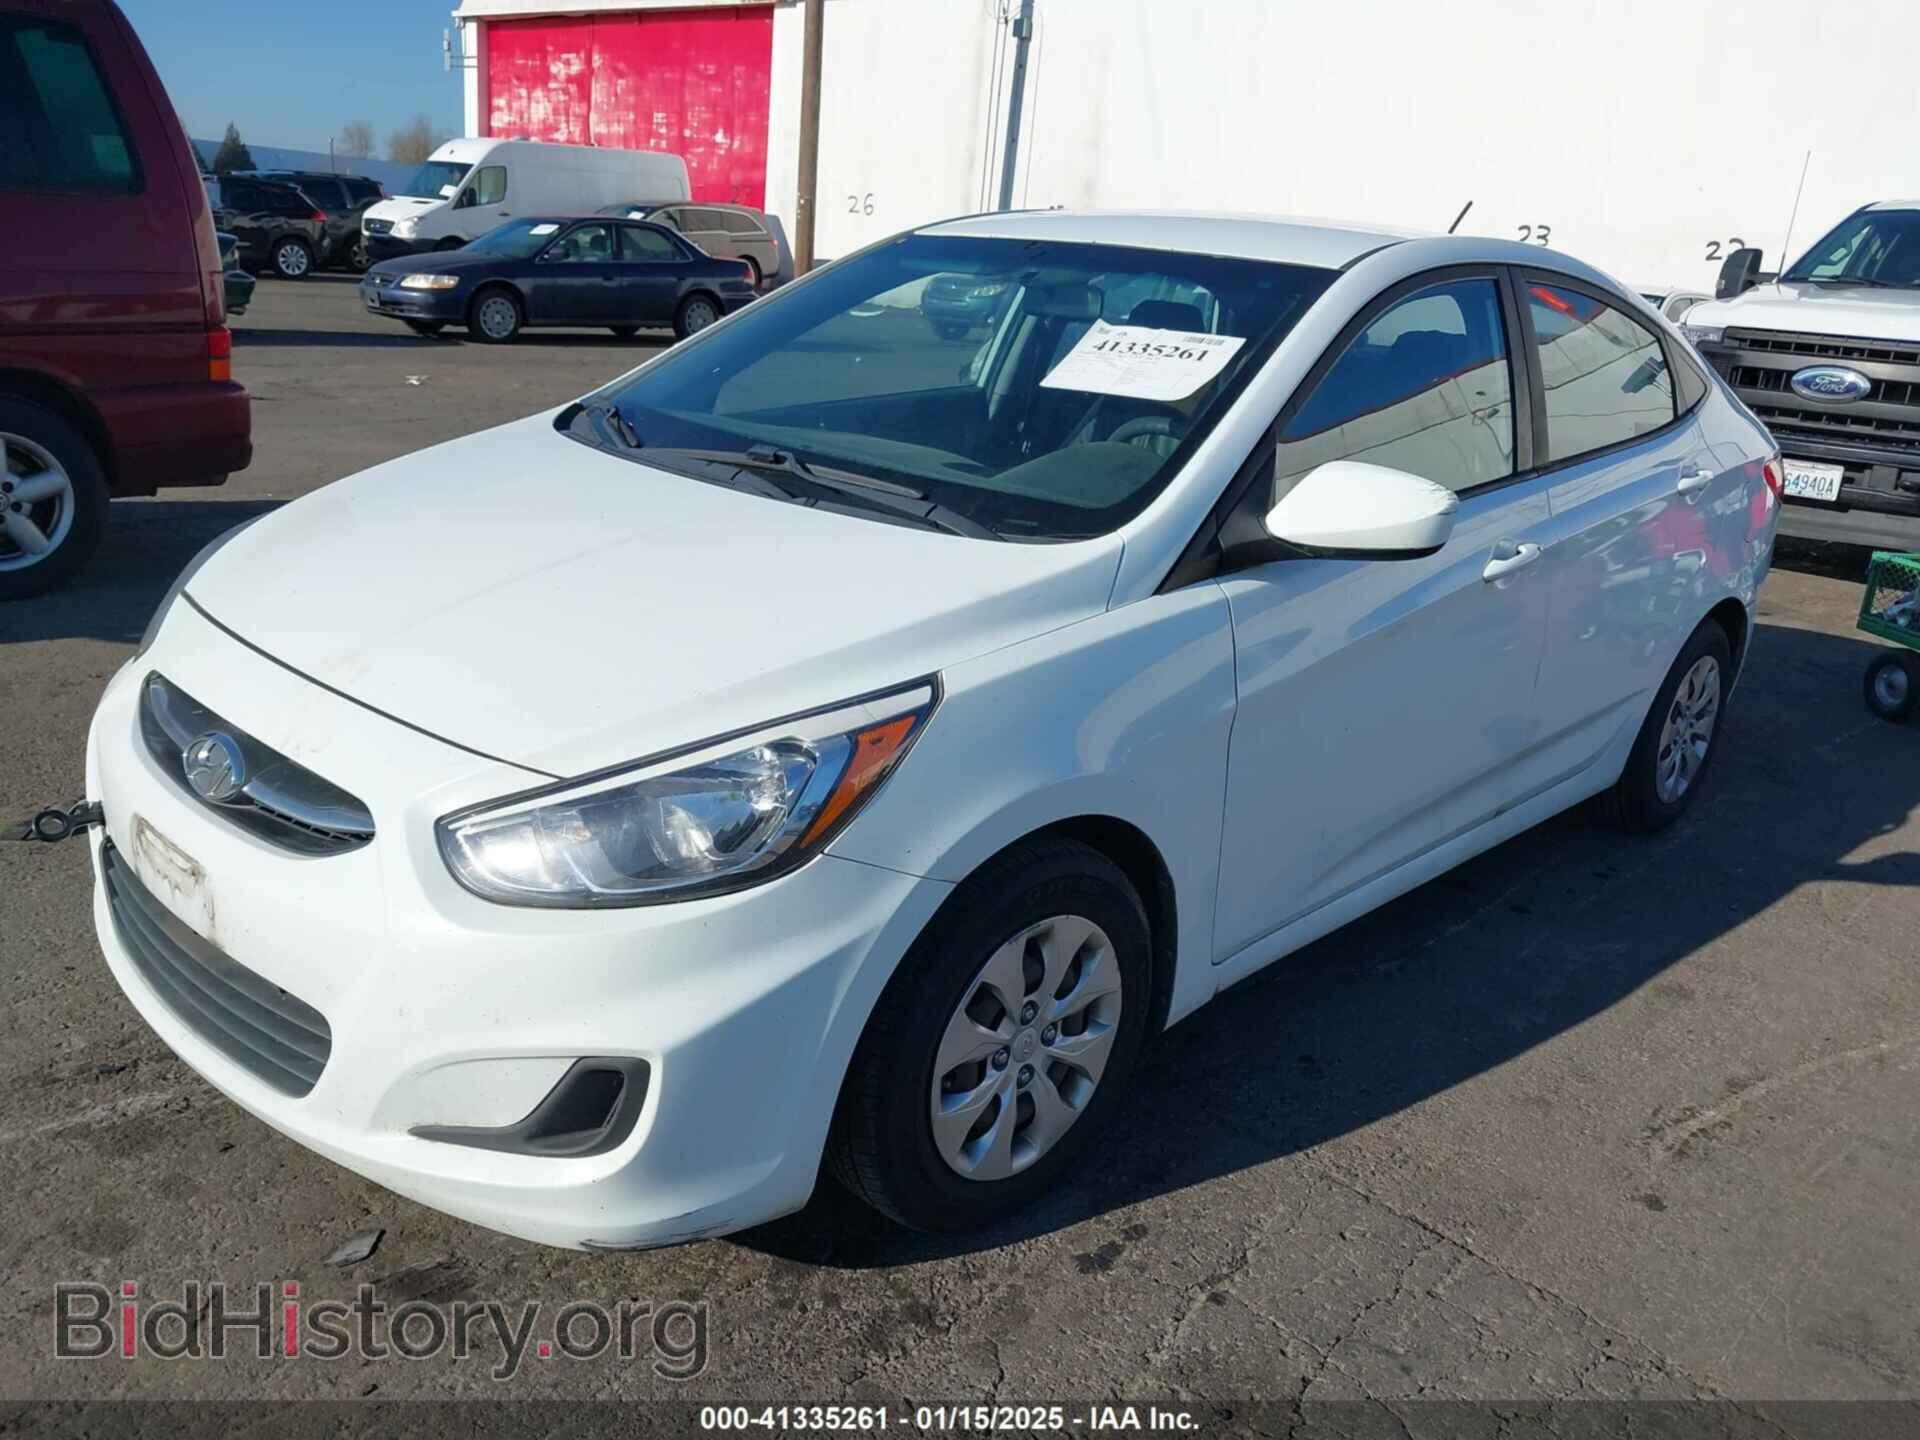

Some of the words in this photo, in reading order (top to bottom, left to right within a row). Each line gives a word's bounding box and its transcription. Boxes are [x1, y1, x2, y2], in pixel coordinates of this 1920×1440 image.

[847, 193, 875, 216] 26
[1093, 340, 1208, 361] 41335261
[1810, 376, 1849, 392] Ford
